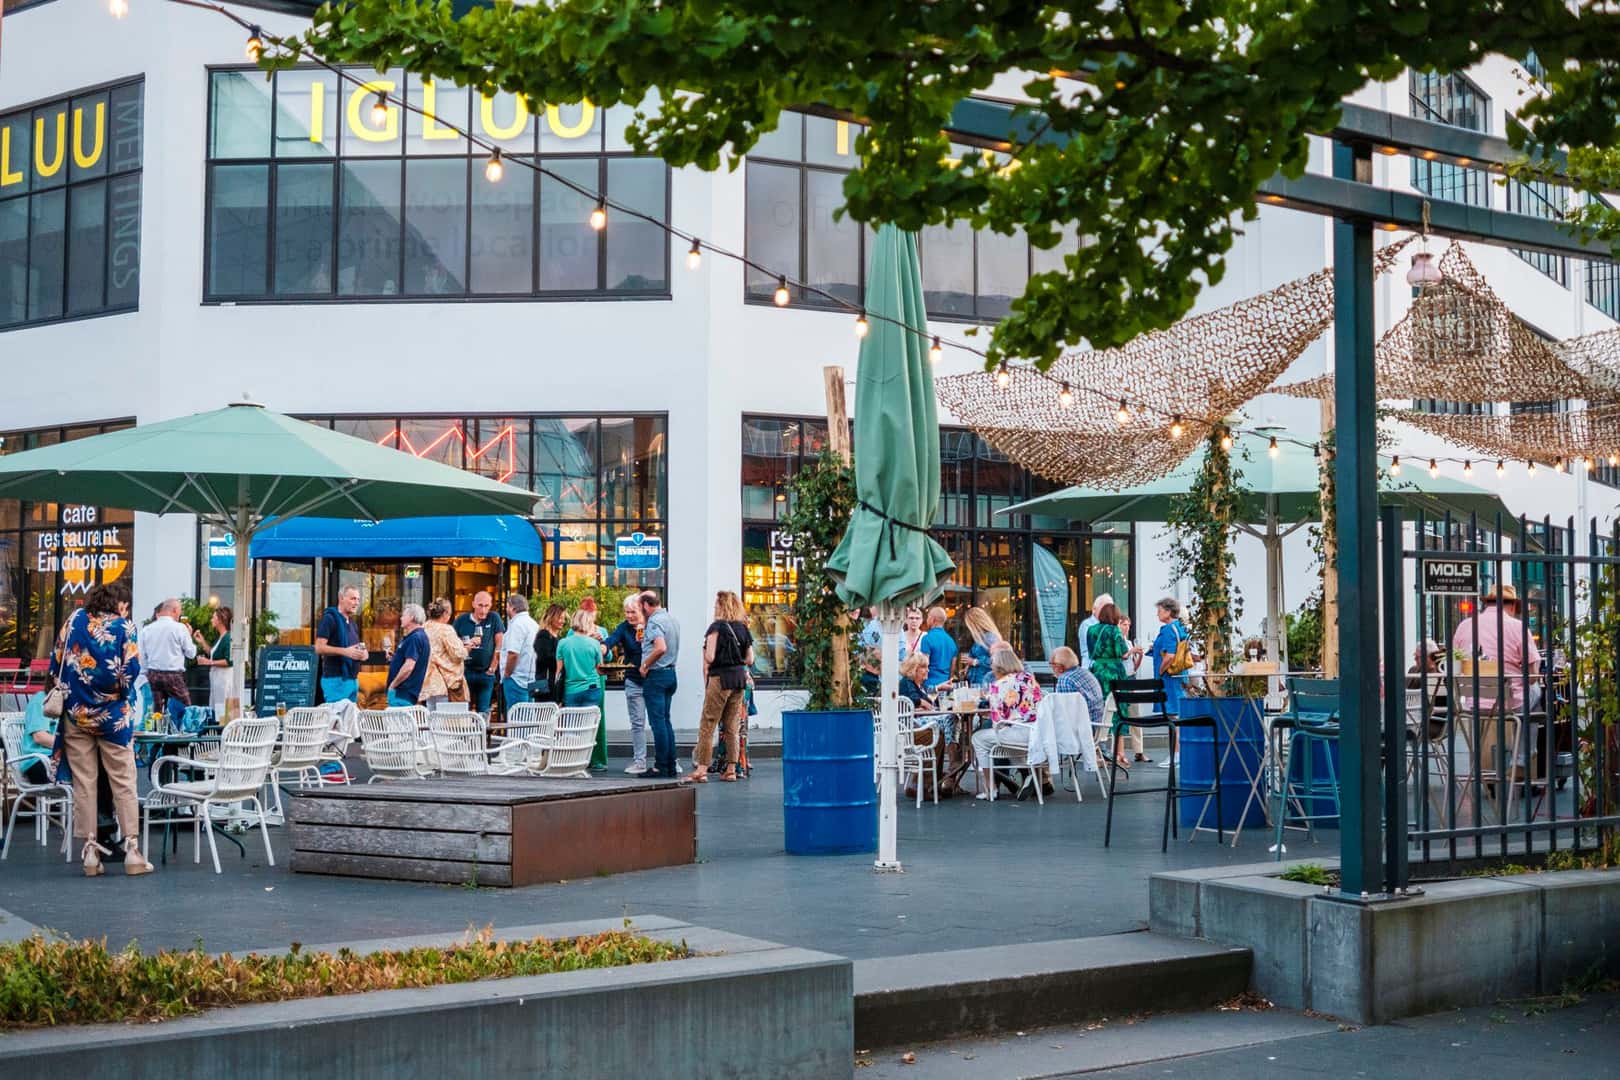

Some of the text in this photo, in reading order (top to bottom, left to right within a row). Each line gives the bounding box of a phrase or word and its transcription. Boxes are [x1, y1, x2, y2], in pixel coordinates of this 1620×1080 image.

[309, 80, 596, 144] IGLUU
[1, 102, 106, 187] LUU
[38, 526, 121, 549] restaurant
[37, 550, 119, 572] Eindhoven
[618, 545, 659, 556] Bavaria
[1429, 563, 1473, 577] MOLS
